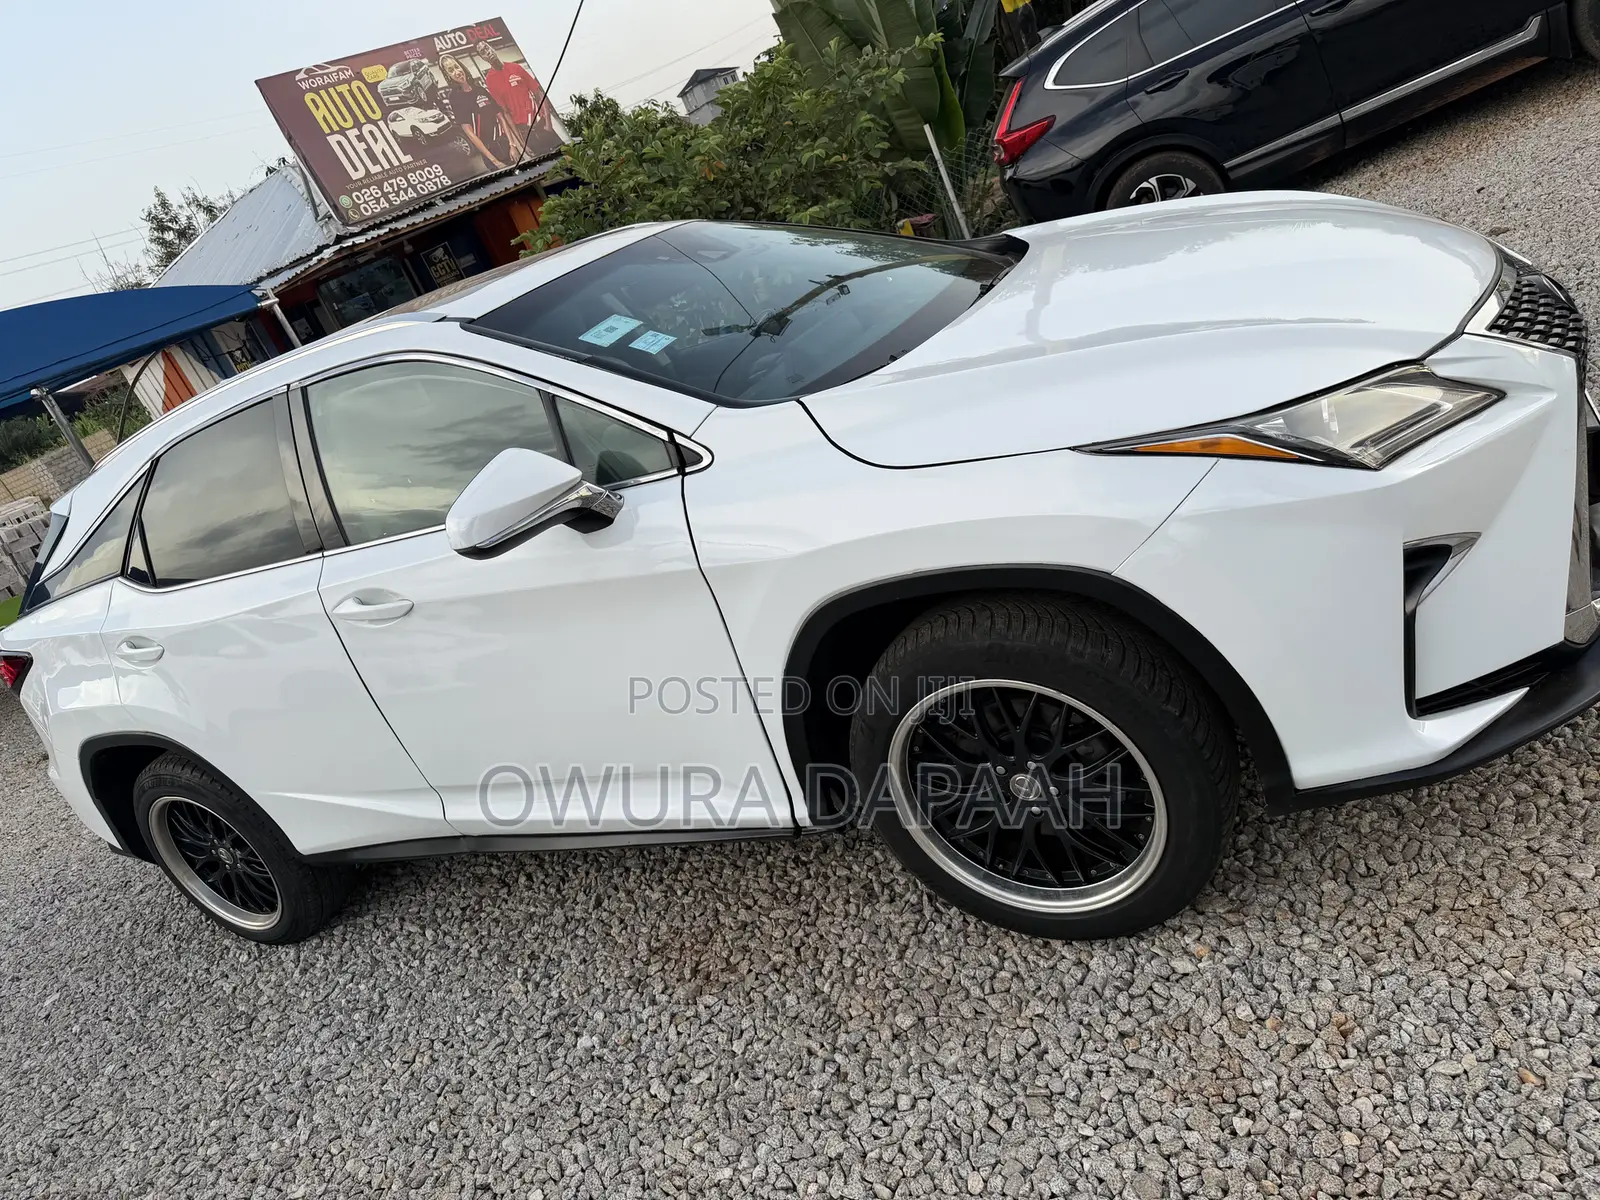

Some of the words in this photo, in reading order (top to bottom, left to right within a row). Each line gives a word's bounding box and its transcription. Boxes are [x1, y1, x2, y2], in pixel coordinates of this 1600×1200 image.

[434, 31, 467, 51] AUTO
[466, 24, 500, 41] DEAL
[297, 69, 355, 90] WORAIFAM
[304, 80, 382, 134] AUTO
[326, 120, 414, 180] DEAL
[345, 180, 363, 190] YOUR
[362, 173, 389, 185] RELIABLE
[388, 166, 403, 176] AUTO
[403, 159, 428, 172] PARTNER
[352, 185, 382, 204] 026
[383, 176, 408, 193] 479
[407, 164, 443, 185] 8009
[360, 197, 390, 216] 054
[388, 187, 417, 205] 544
[416, 175, 452, 195] 0878
[430, 258, 457, 278] CCTV
